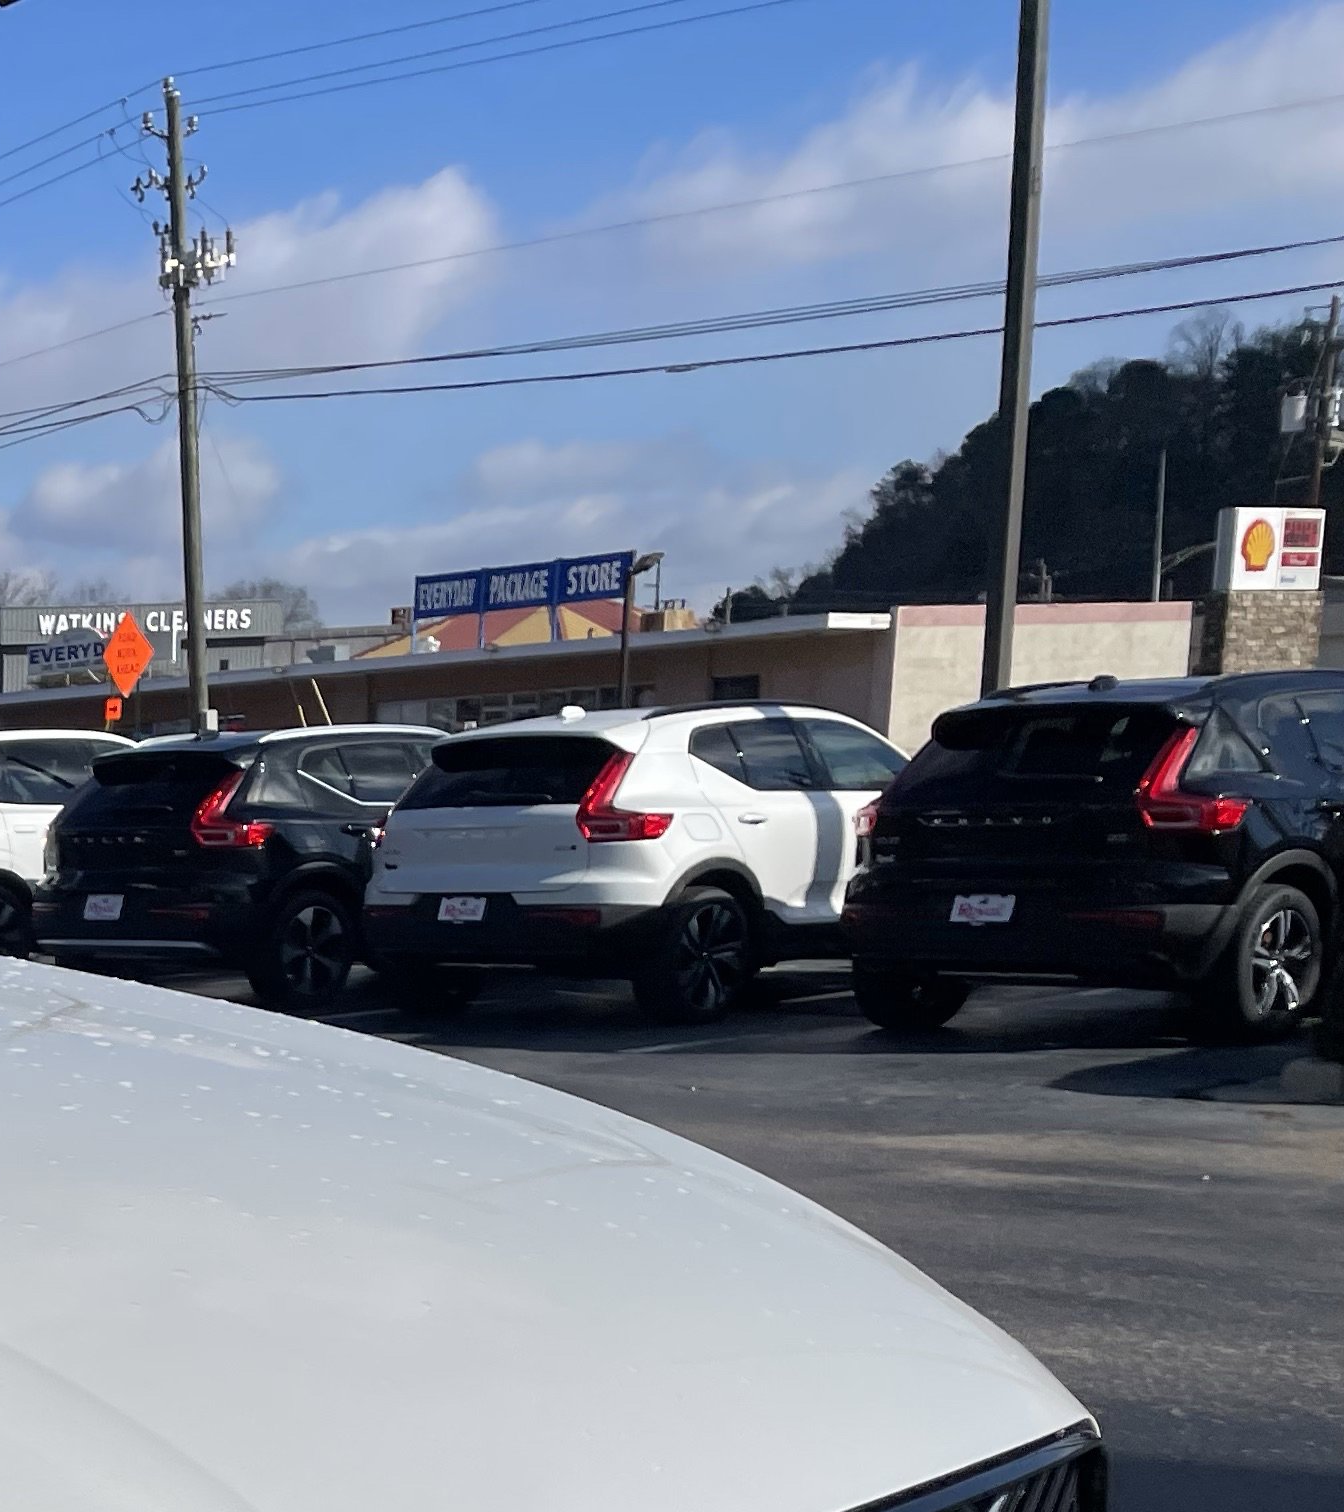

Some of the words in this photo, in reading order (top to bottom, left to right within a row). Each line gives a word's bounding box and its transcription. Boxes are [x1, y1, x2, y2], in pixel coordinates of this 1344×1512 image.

[418, 578, 477, 611] EVERYDAY
[489, 568, 549, 604] PACKAGE
[566, 560, 622, 596] STORE
[145, 608, 252, 633] CLENERS
